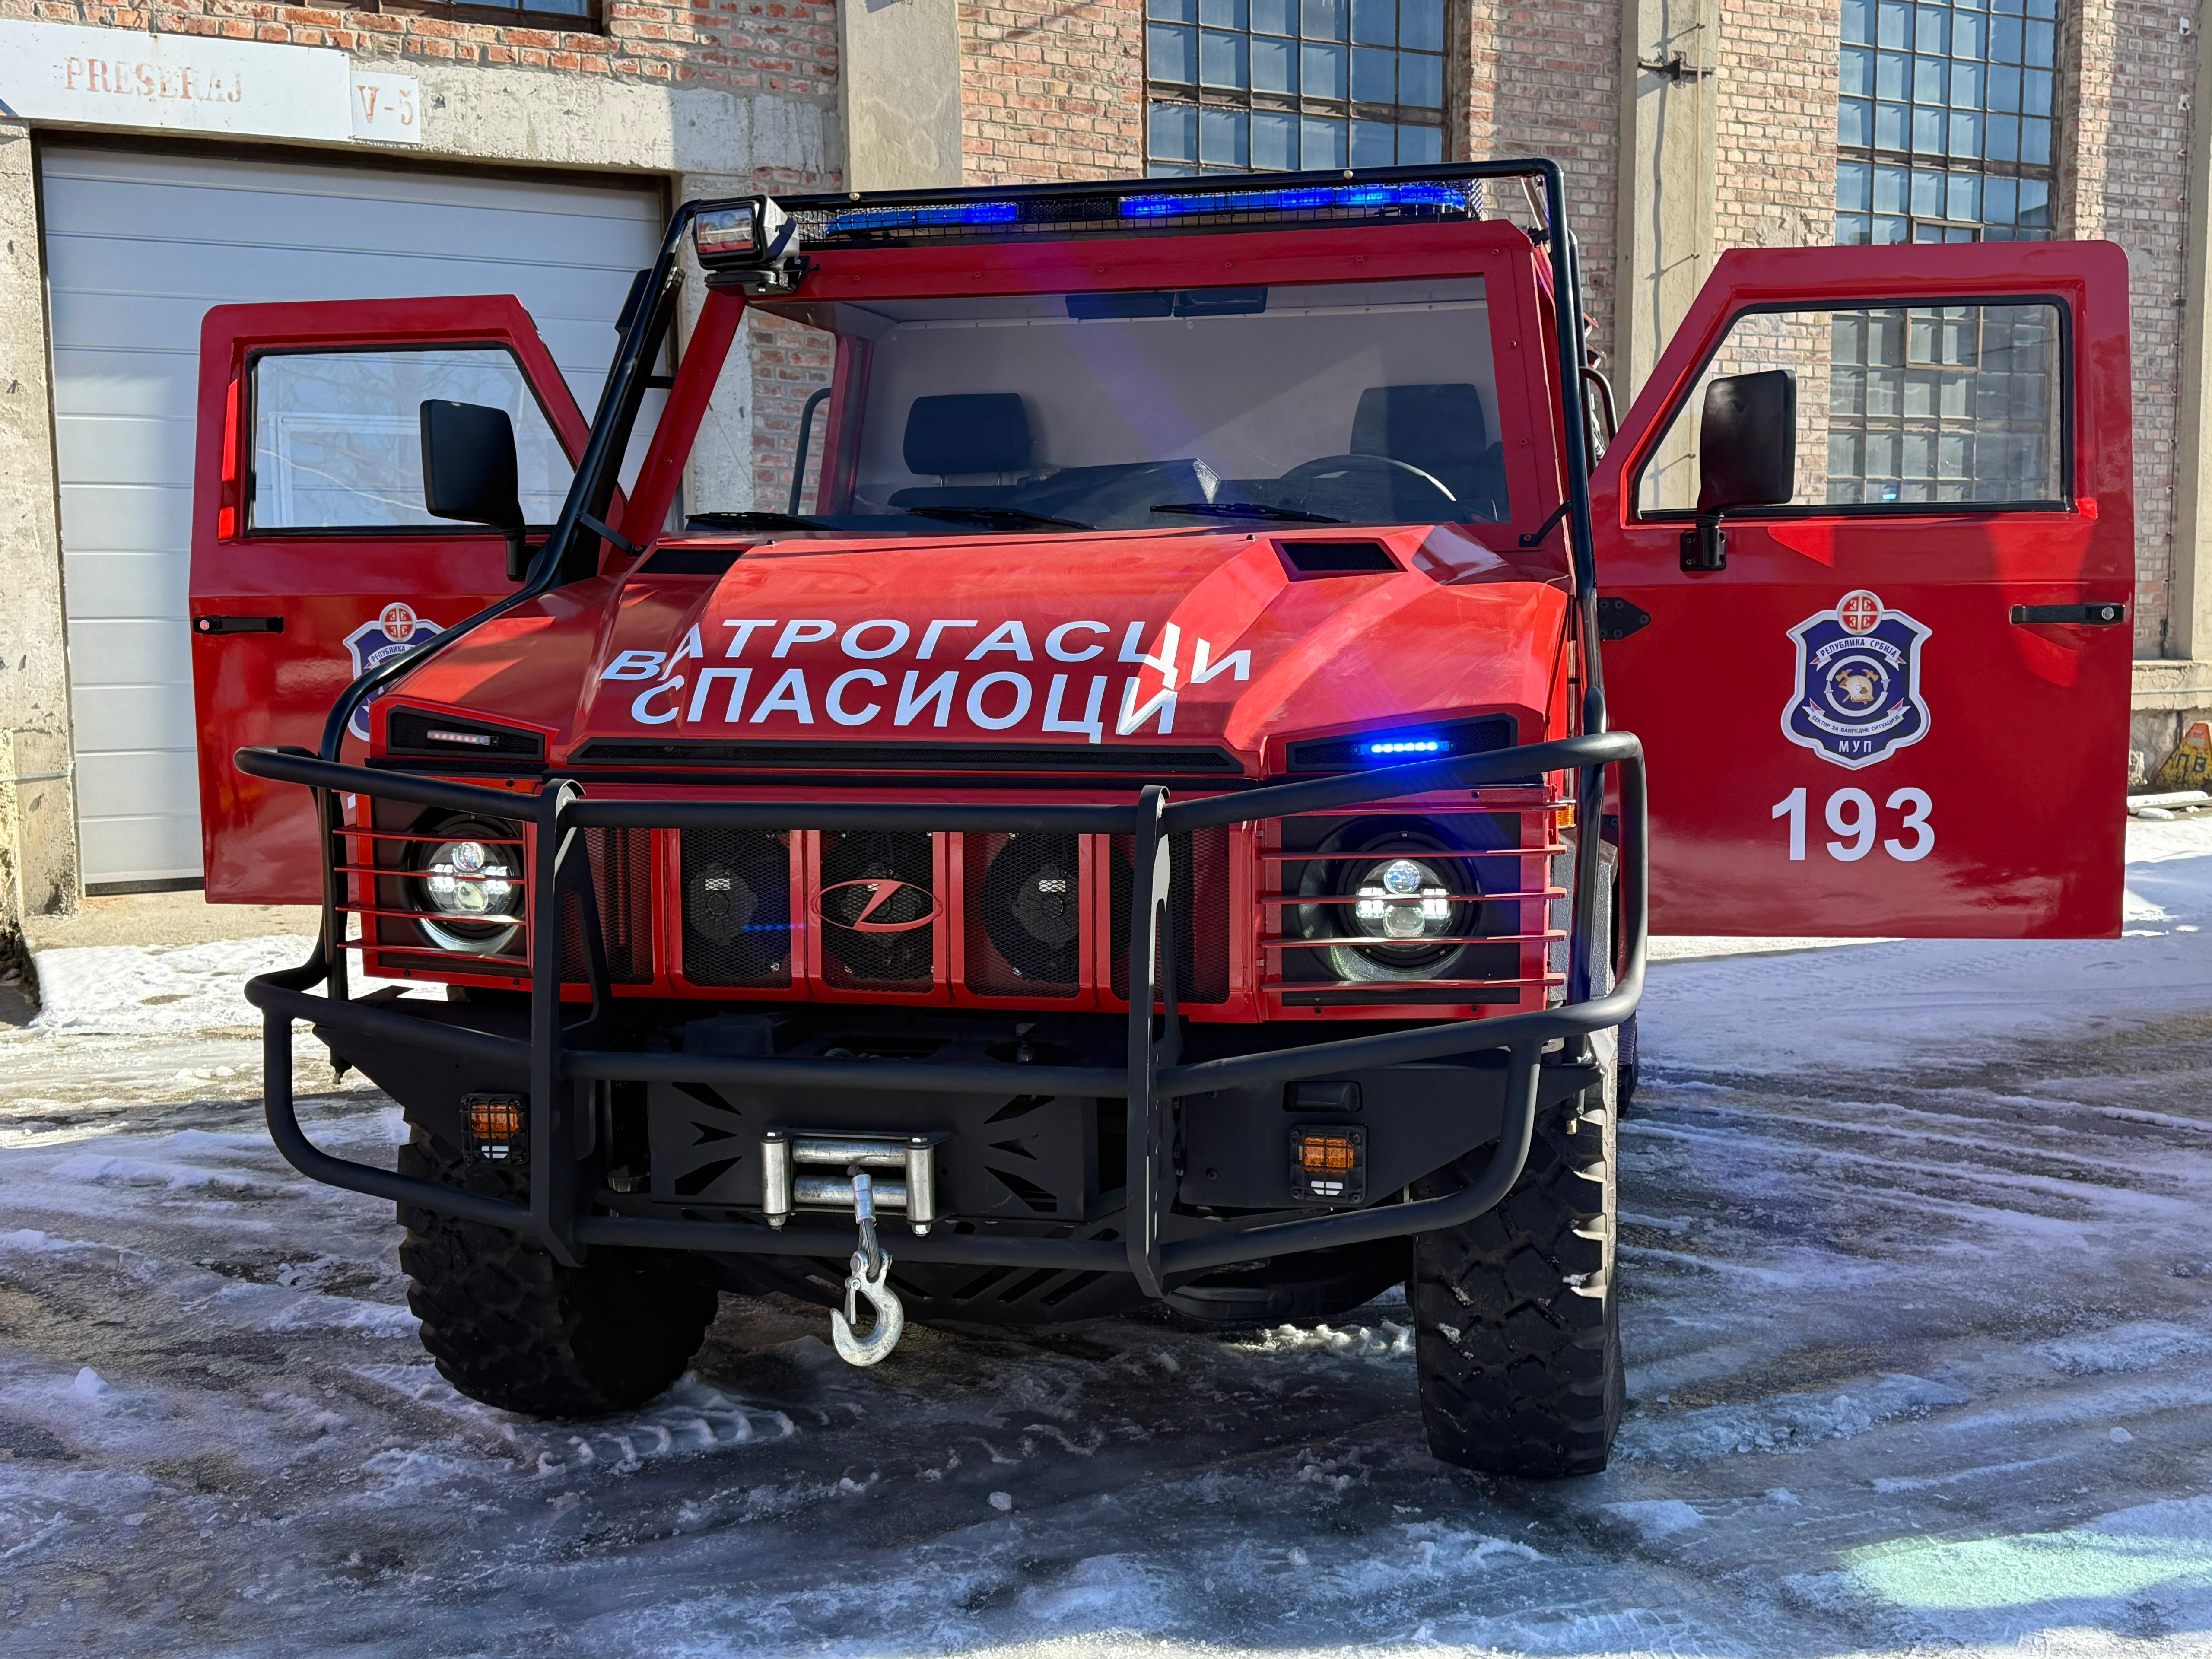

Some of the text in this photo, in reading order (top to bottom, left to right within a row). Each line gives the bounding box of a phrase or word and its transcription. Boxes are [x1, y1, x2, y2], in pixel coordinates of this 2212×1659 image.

[356, 85, 413, 126] V-5
[371, 645, 406, 663] РЕПУБЛИКА
[600, 619, 1252, 690] ВАТРОГАСЦИ
[1820, 639, 1897, 658] РЕПУБЛИКА СРБИЈА
[631, 667, 1179, 744] СПАСИОЦИ
[1812, 715, 1831, 728] СЕКТОР
[1871, 714, 1901, 731] СИТУАЦИЈЕ
[1839, 740, 1872, 753] МУП
[1772, 787, 1935, 862] 193
